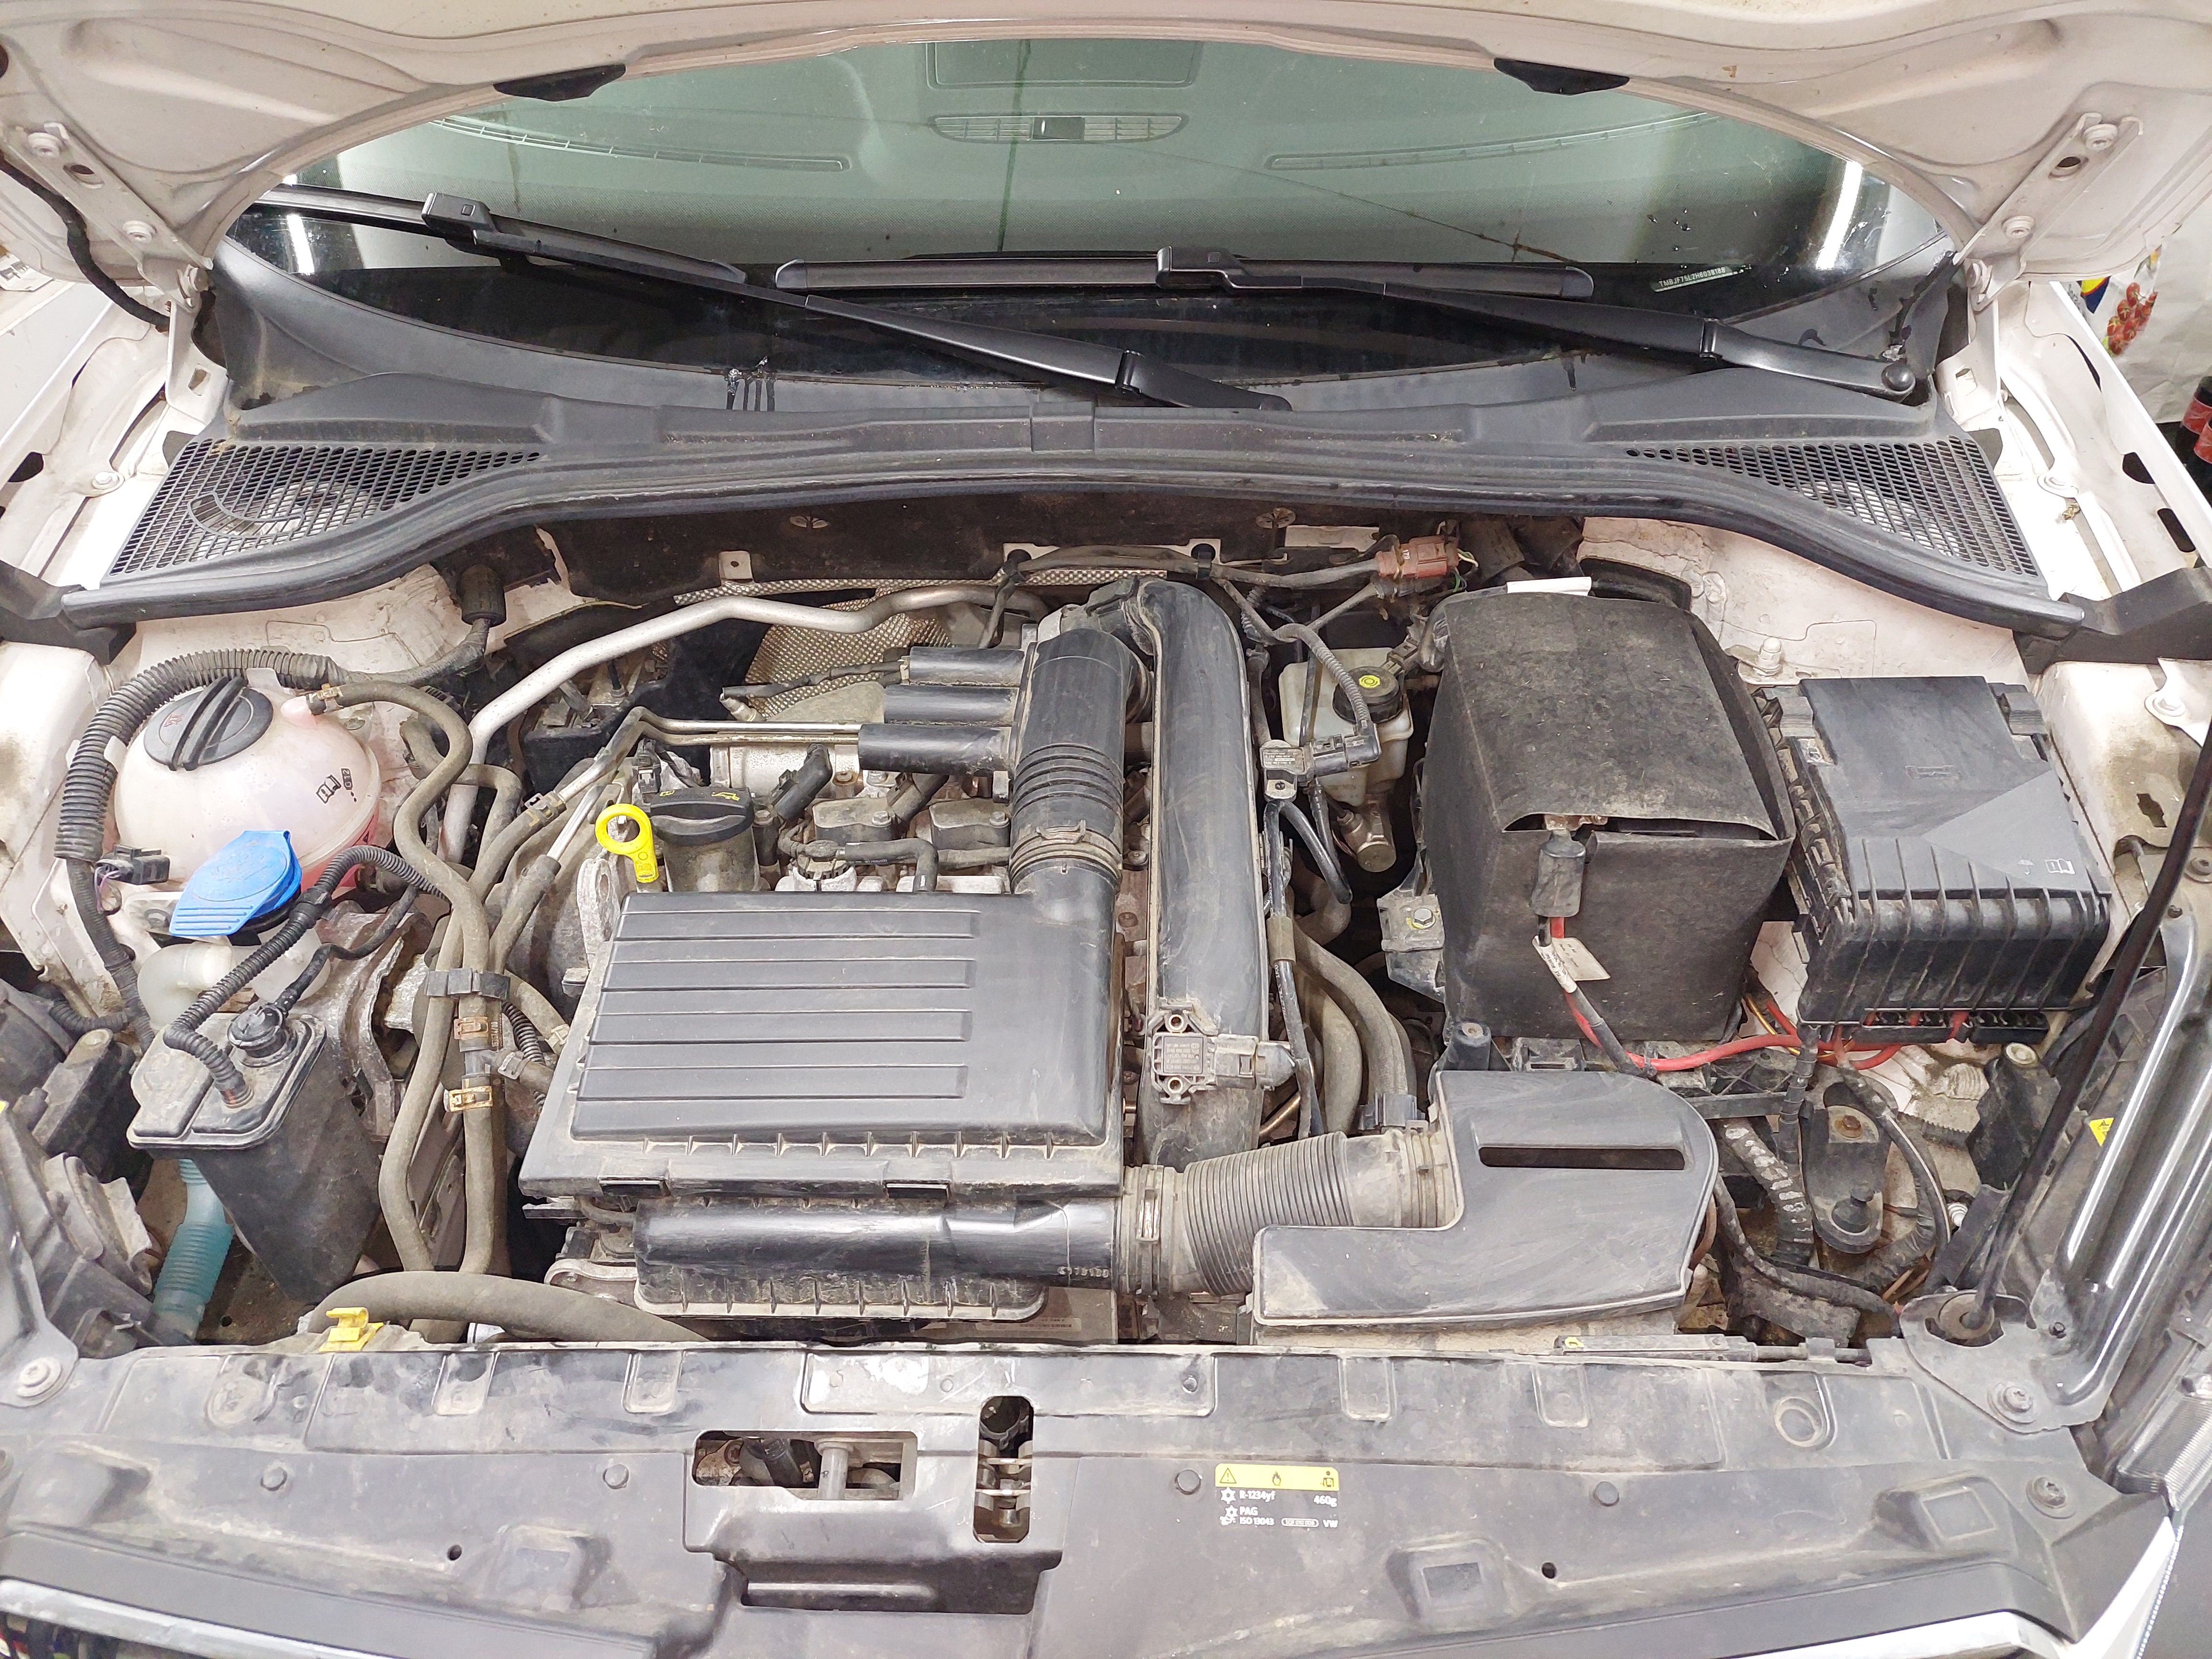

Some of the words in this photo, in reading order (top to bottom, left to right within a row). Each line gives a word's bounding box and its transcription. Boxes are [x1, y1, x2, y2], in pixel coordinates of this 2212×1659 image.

[342, 769, 352, 788] G12
[1239, 1490, 1276, 1503] R-1234yf
[1313, 1495, 1338, 1507] 460g
[1239, 1506, 1258, 1516] PAG
[1239, 1516, 1253, 1525] ISO
[1253, 1517, 1275, 1526] 13043
[1323, 1519, 1338, 1528] VW
